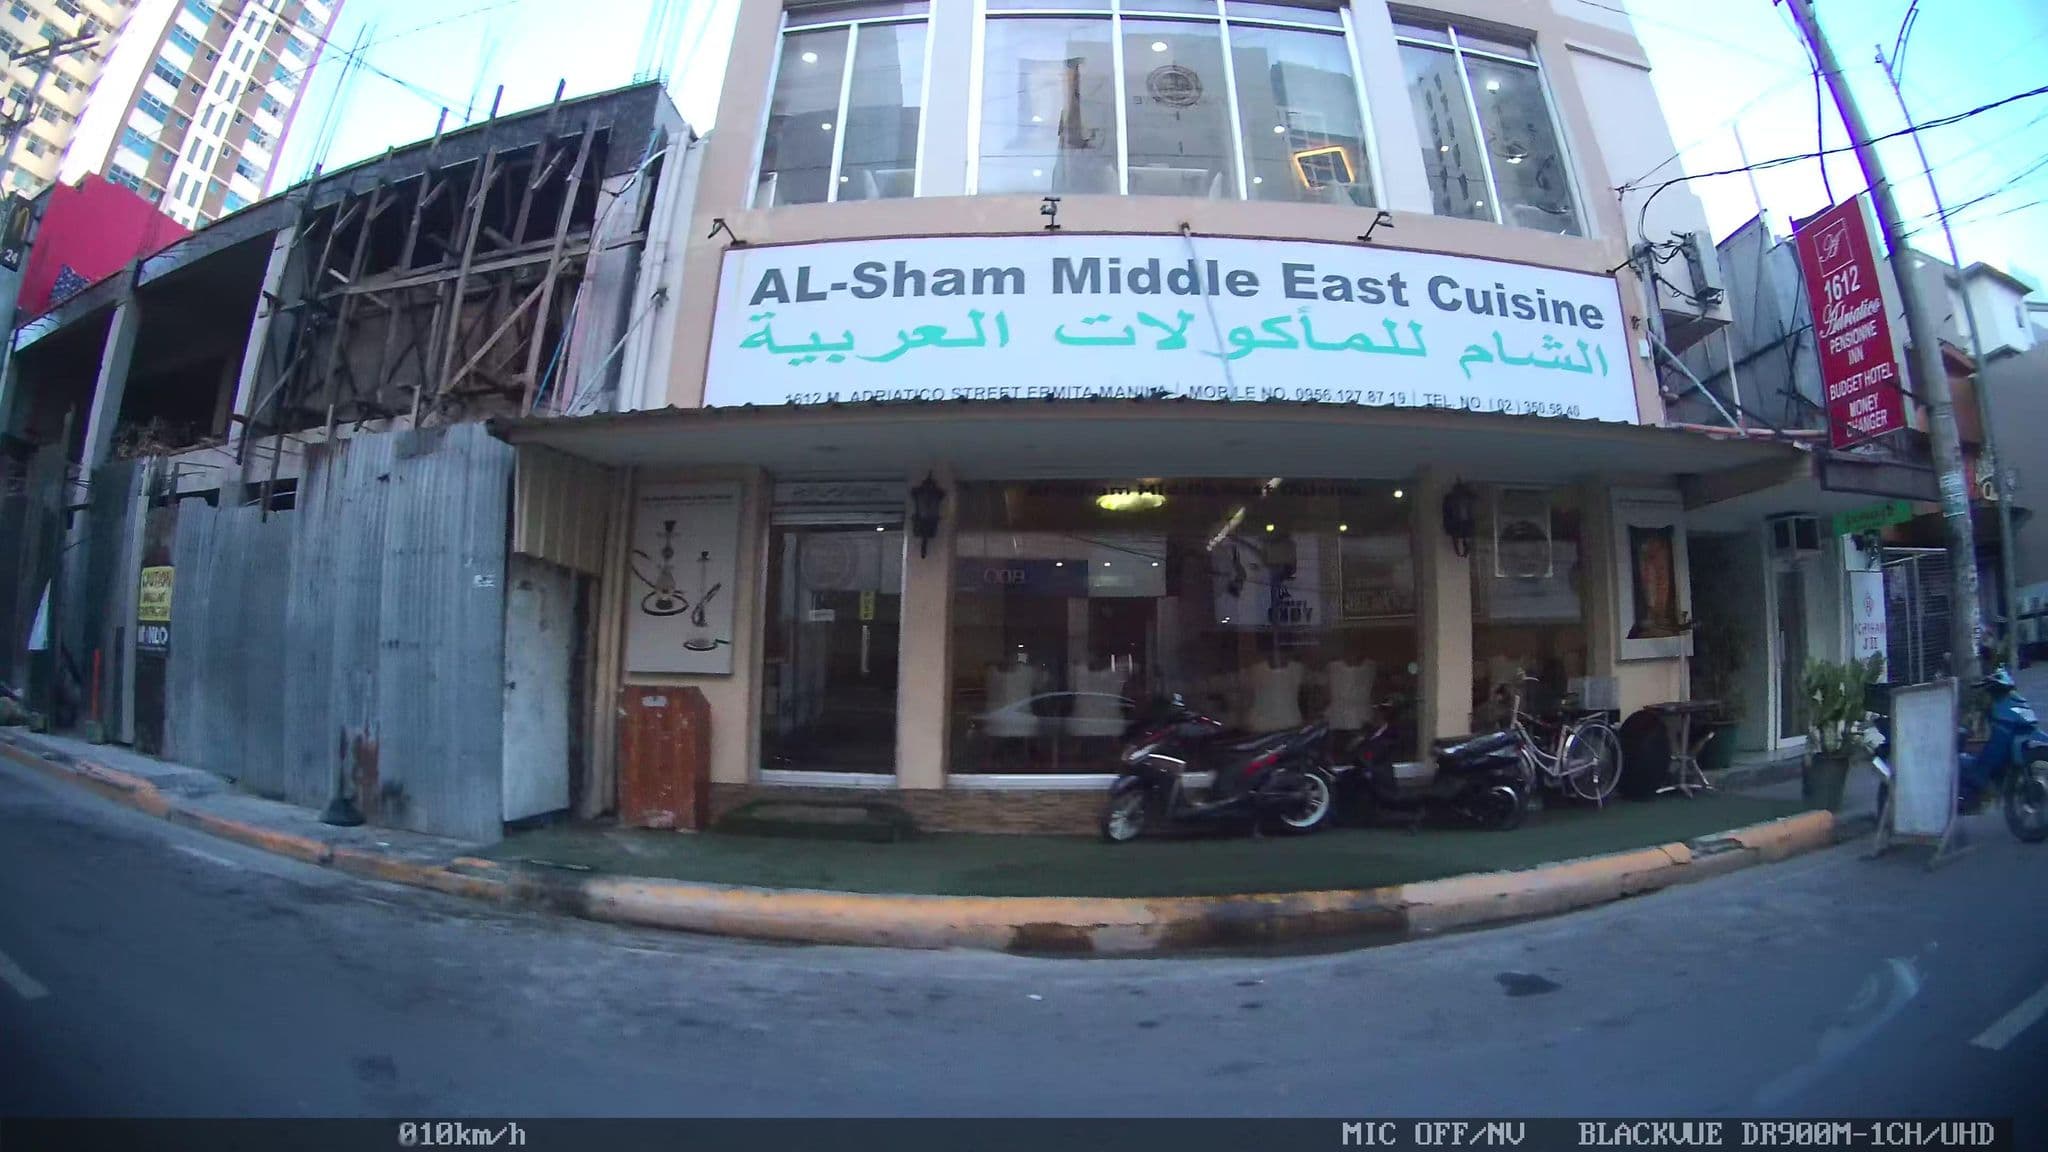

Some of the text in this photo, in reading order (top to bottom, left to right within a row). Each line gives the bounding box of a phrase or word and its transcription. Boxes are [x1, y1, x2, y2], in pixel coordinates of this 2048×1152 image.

[747, 256, 1605, 330] AL-Sham Middle East Cuisine
[1824, 265, 1860, 304] 1612
[739, 308, 1010, 367] العربية
[1458, 329, 1609, 380] الشام
[1848, 345, 1864, 366] INN
[851, 387, 945, 402] ADRIATICO
[952, 386, 1022, 399] STREET
[1099, 385, 1165, 398] MANIA
[1189, 385, 1256, 399] MOBILE
[1829, 362, 1893, 401] BUDGET HOTEL
[1849, 393, 1878, 417] MONEY
